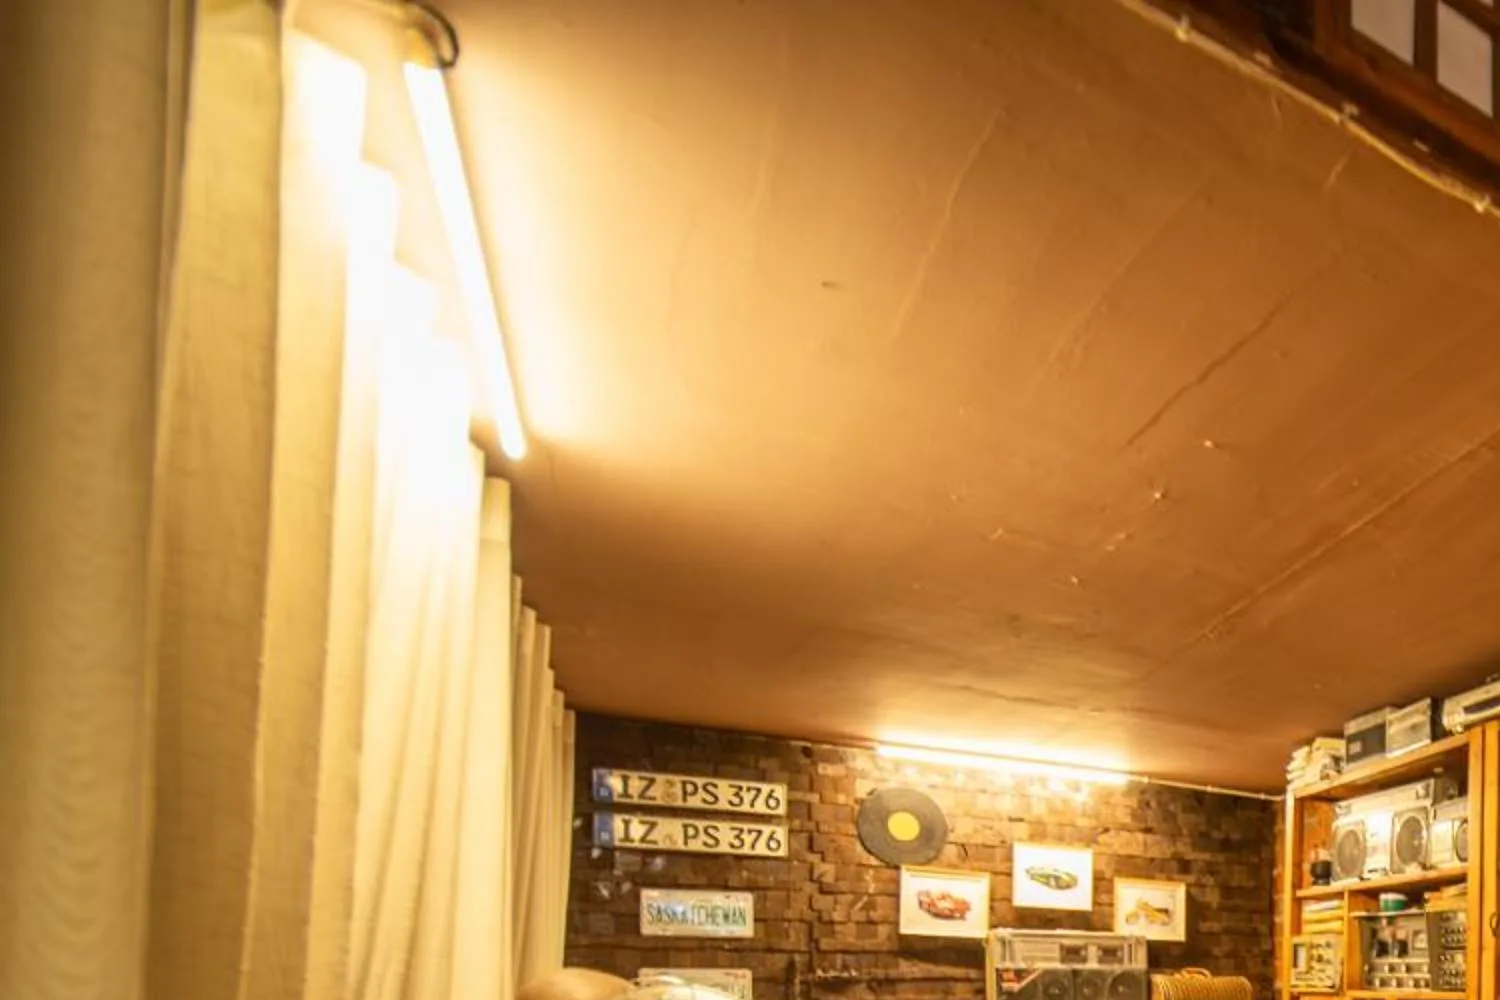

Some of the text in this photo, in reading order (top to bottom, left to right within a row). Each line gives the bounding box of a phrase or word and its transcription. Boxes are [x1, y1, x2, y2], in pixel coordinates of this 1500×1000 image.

[617, 774, 657, 800] IZ
[680, 780, 719, 805] PS
[727, 783, 781, 811] 376
[618, 818, 659, 845] IZ
[682, 823, 721, 849] PS
[728, 827, 782, 852] 376
